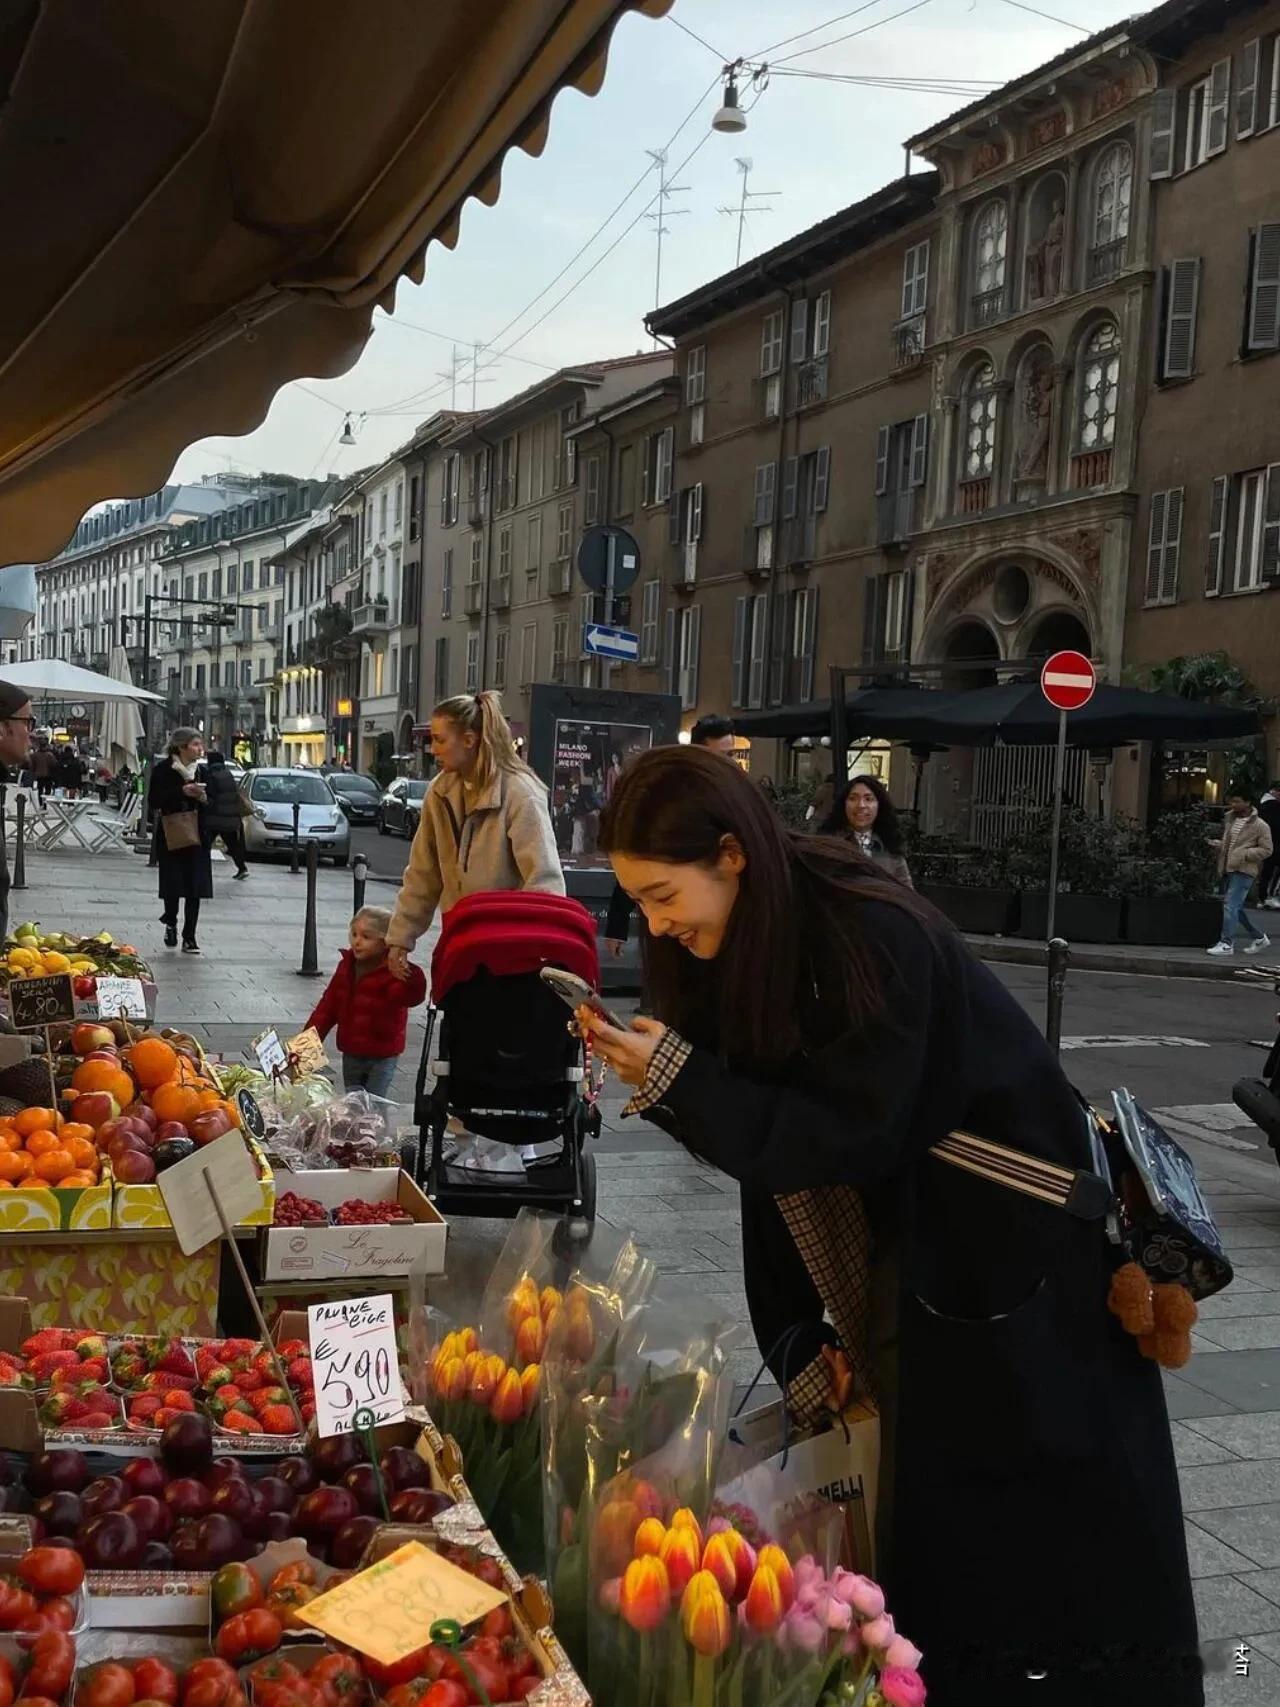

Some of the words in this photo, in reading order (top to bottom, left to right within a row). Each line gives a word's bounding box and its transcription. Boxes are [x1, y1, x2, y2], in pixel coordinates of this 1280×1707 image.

[559, 743, 588, 752] MILANO
[558, 751, 592, 760] FASHION
[558, 759, 580, 768] WEEK
